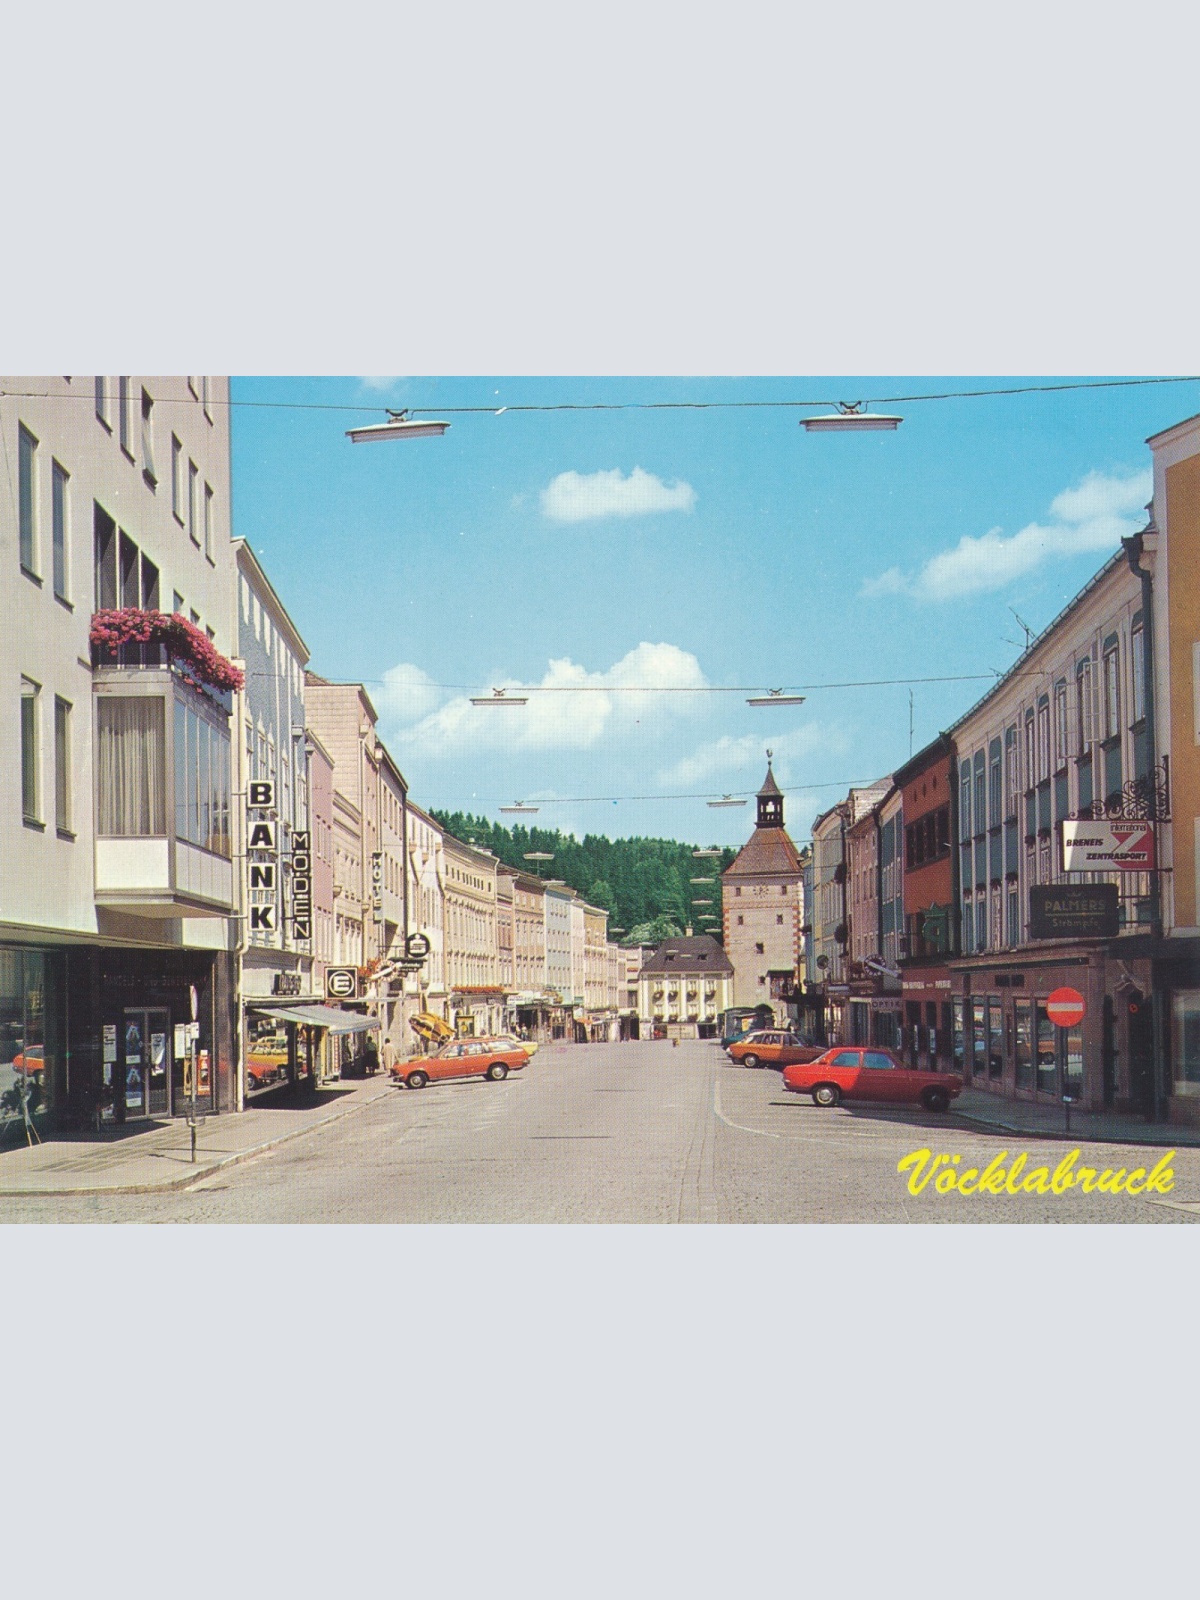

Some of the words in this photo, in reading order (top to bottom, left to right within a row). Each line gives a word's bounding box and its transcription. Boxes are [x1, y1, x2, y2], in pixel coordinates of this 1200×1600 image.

[249, 782, 273, 930] BANK
[1066, 839, 1104, 847] BRENEIS
[1086, 852, 1147, 861] ZENTRASPORT
[292, 832, 310, 939] MODEN
[373, 853, 382, 921] HOTEL
[1044, 899, 1106, 912] PALMERS
